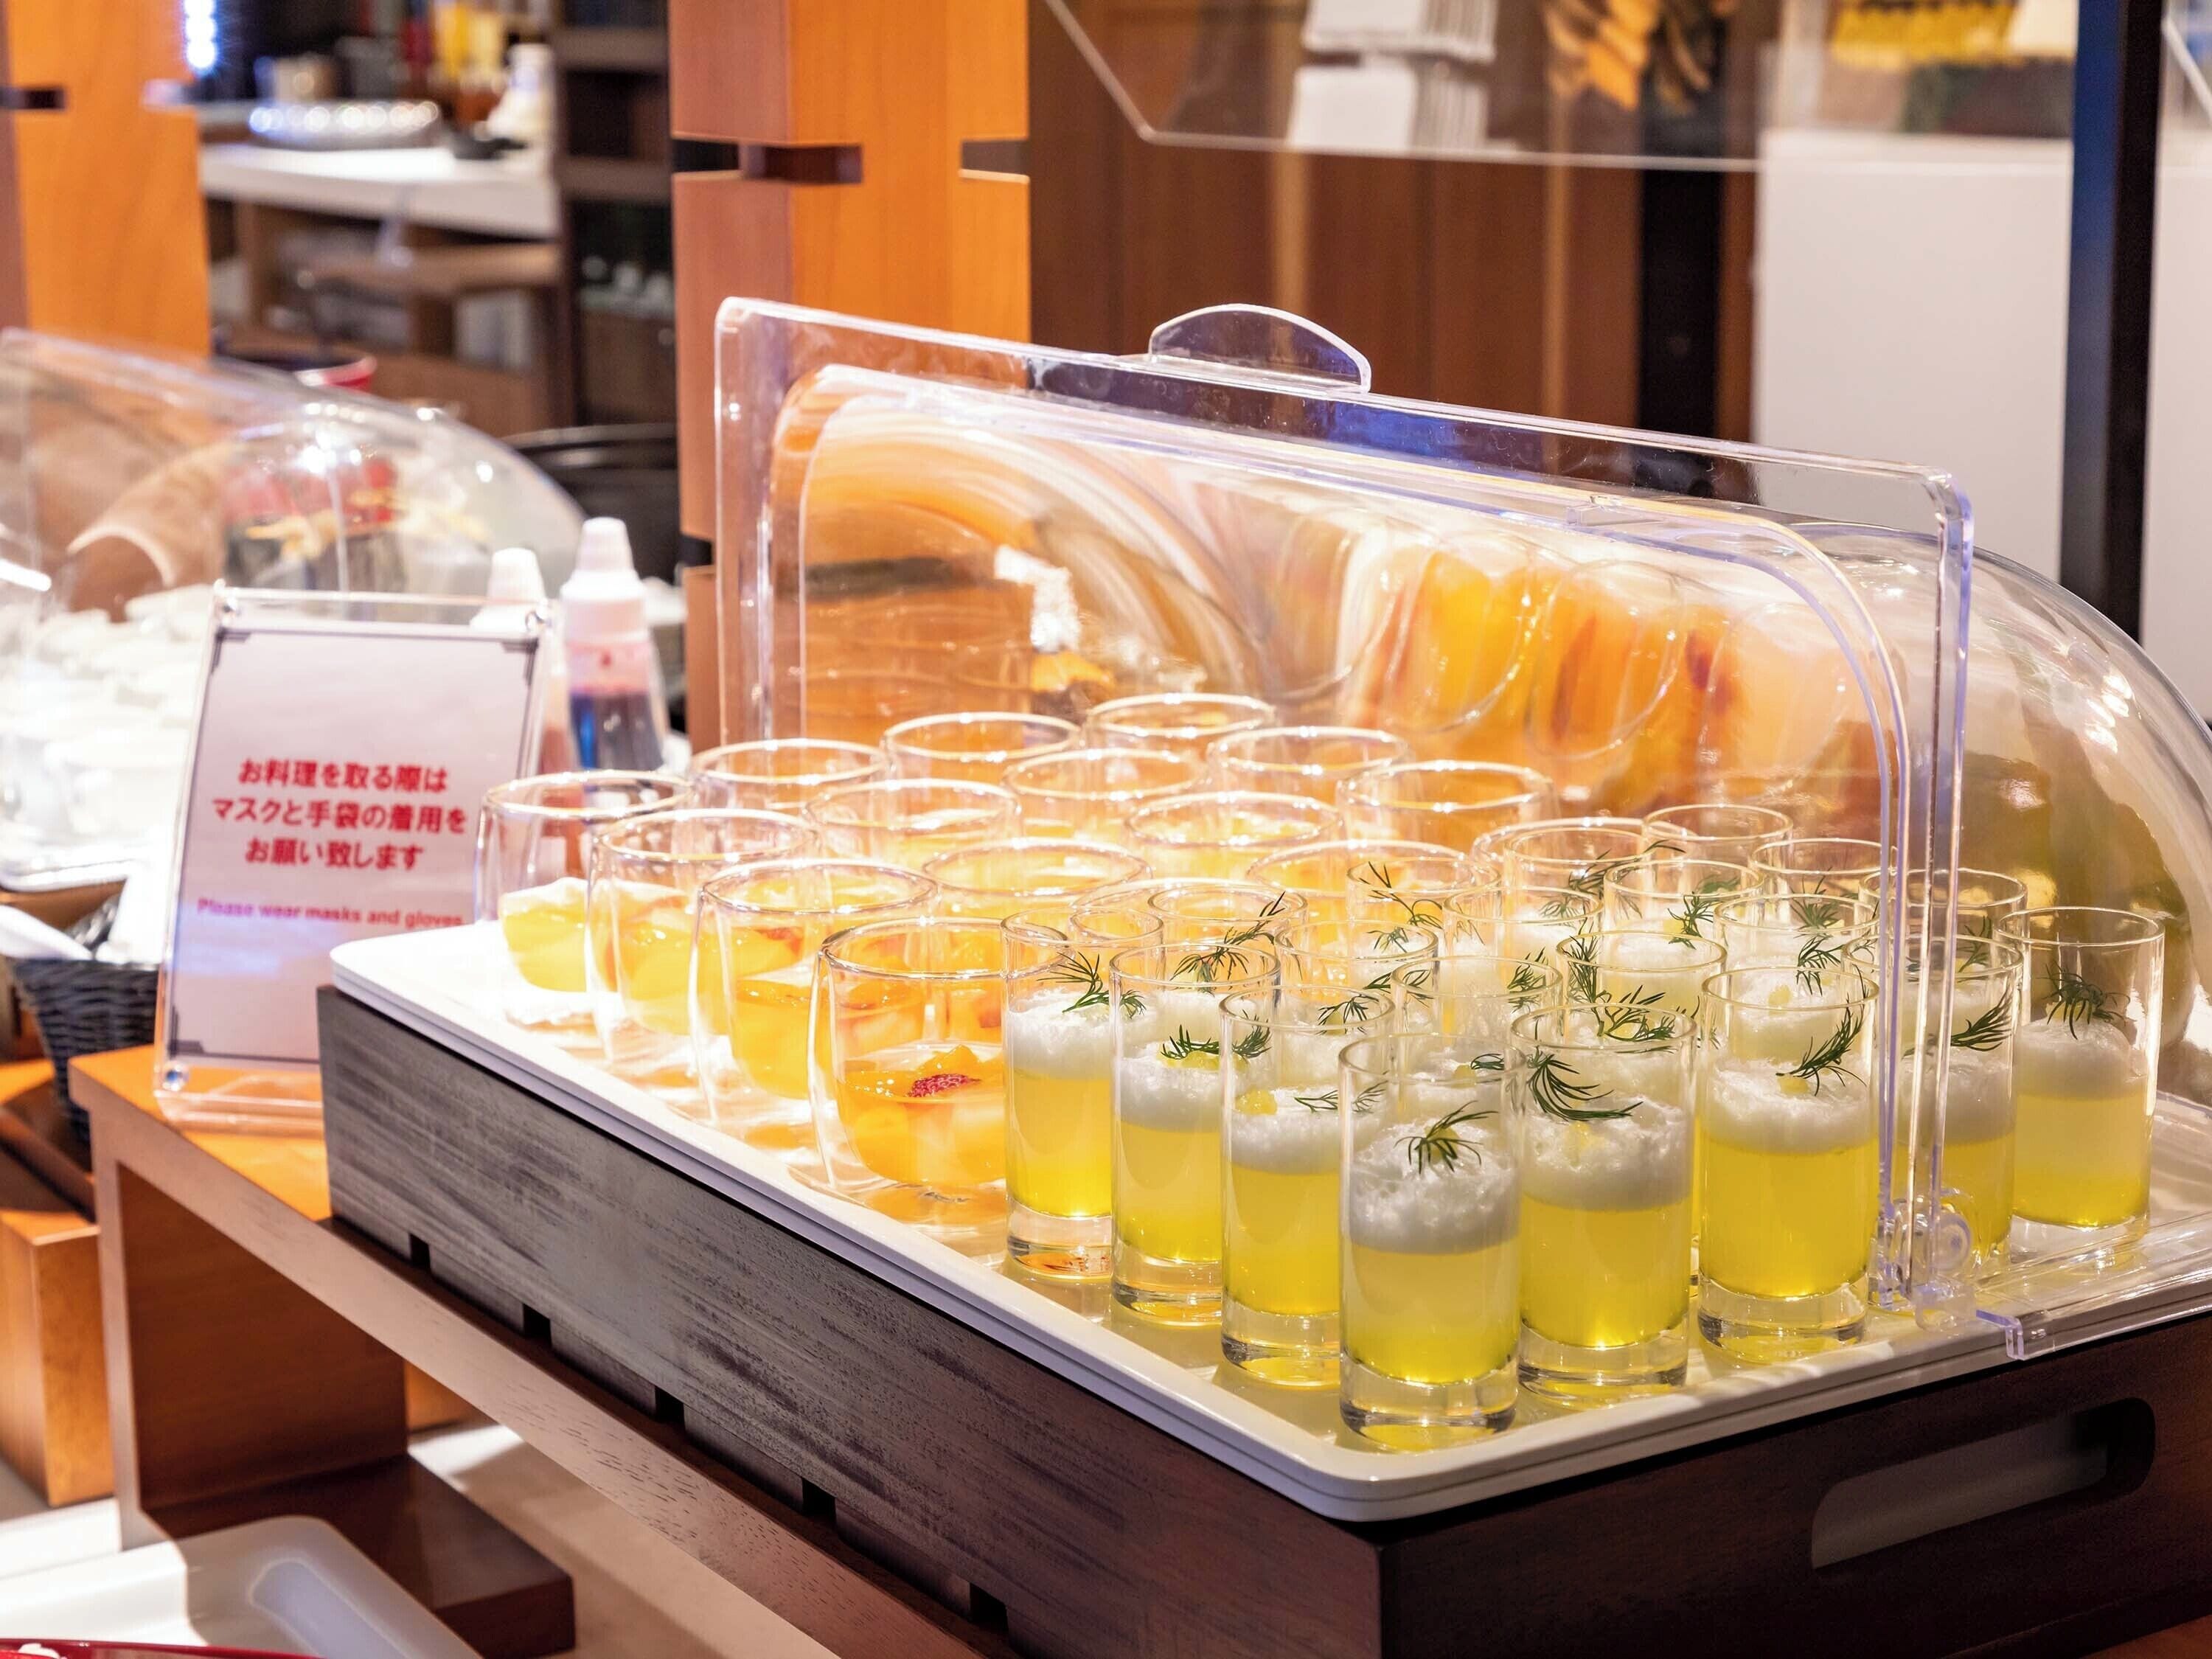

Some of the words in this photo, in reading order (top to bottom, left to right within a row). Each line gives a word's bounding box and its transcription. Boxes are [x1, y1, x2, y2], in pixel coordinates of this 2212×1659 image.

[237, 759, 448, 793] お料理を取る際は
[212, 797, 467, 835] マスクと手袋の着用を
[245, 838, 424, 871] お願い致します
[197, 897, 254, 917] Please
[259, 904, 301, 919] wear
[305, 906, 361, 924] masks
[368, 909, 400, 925] and
